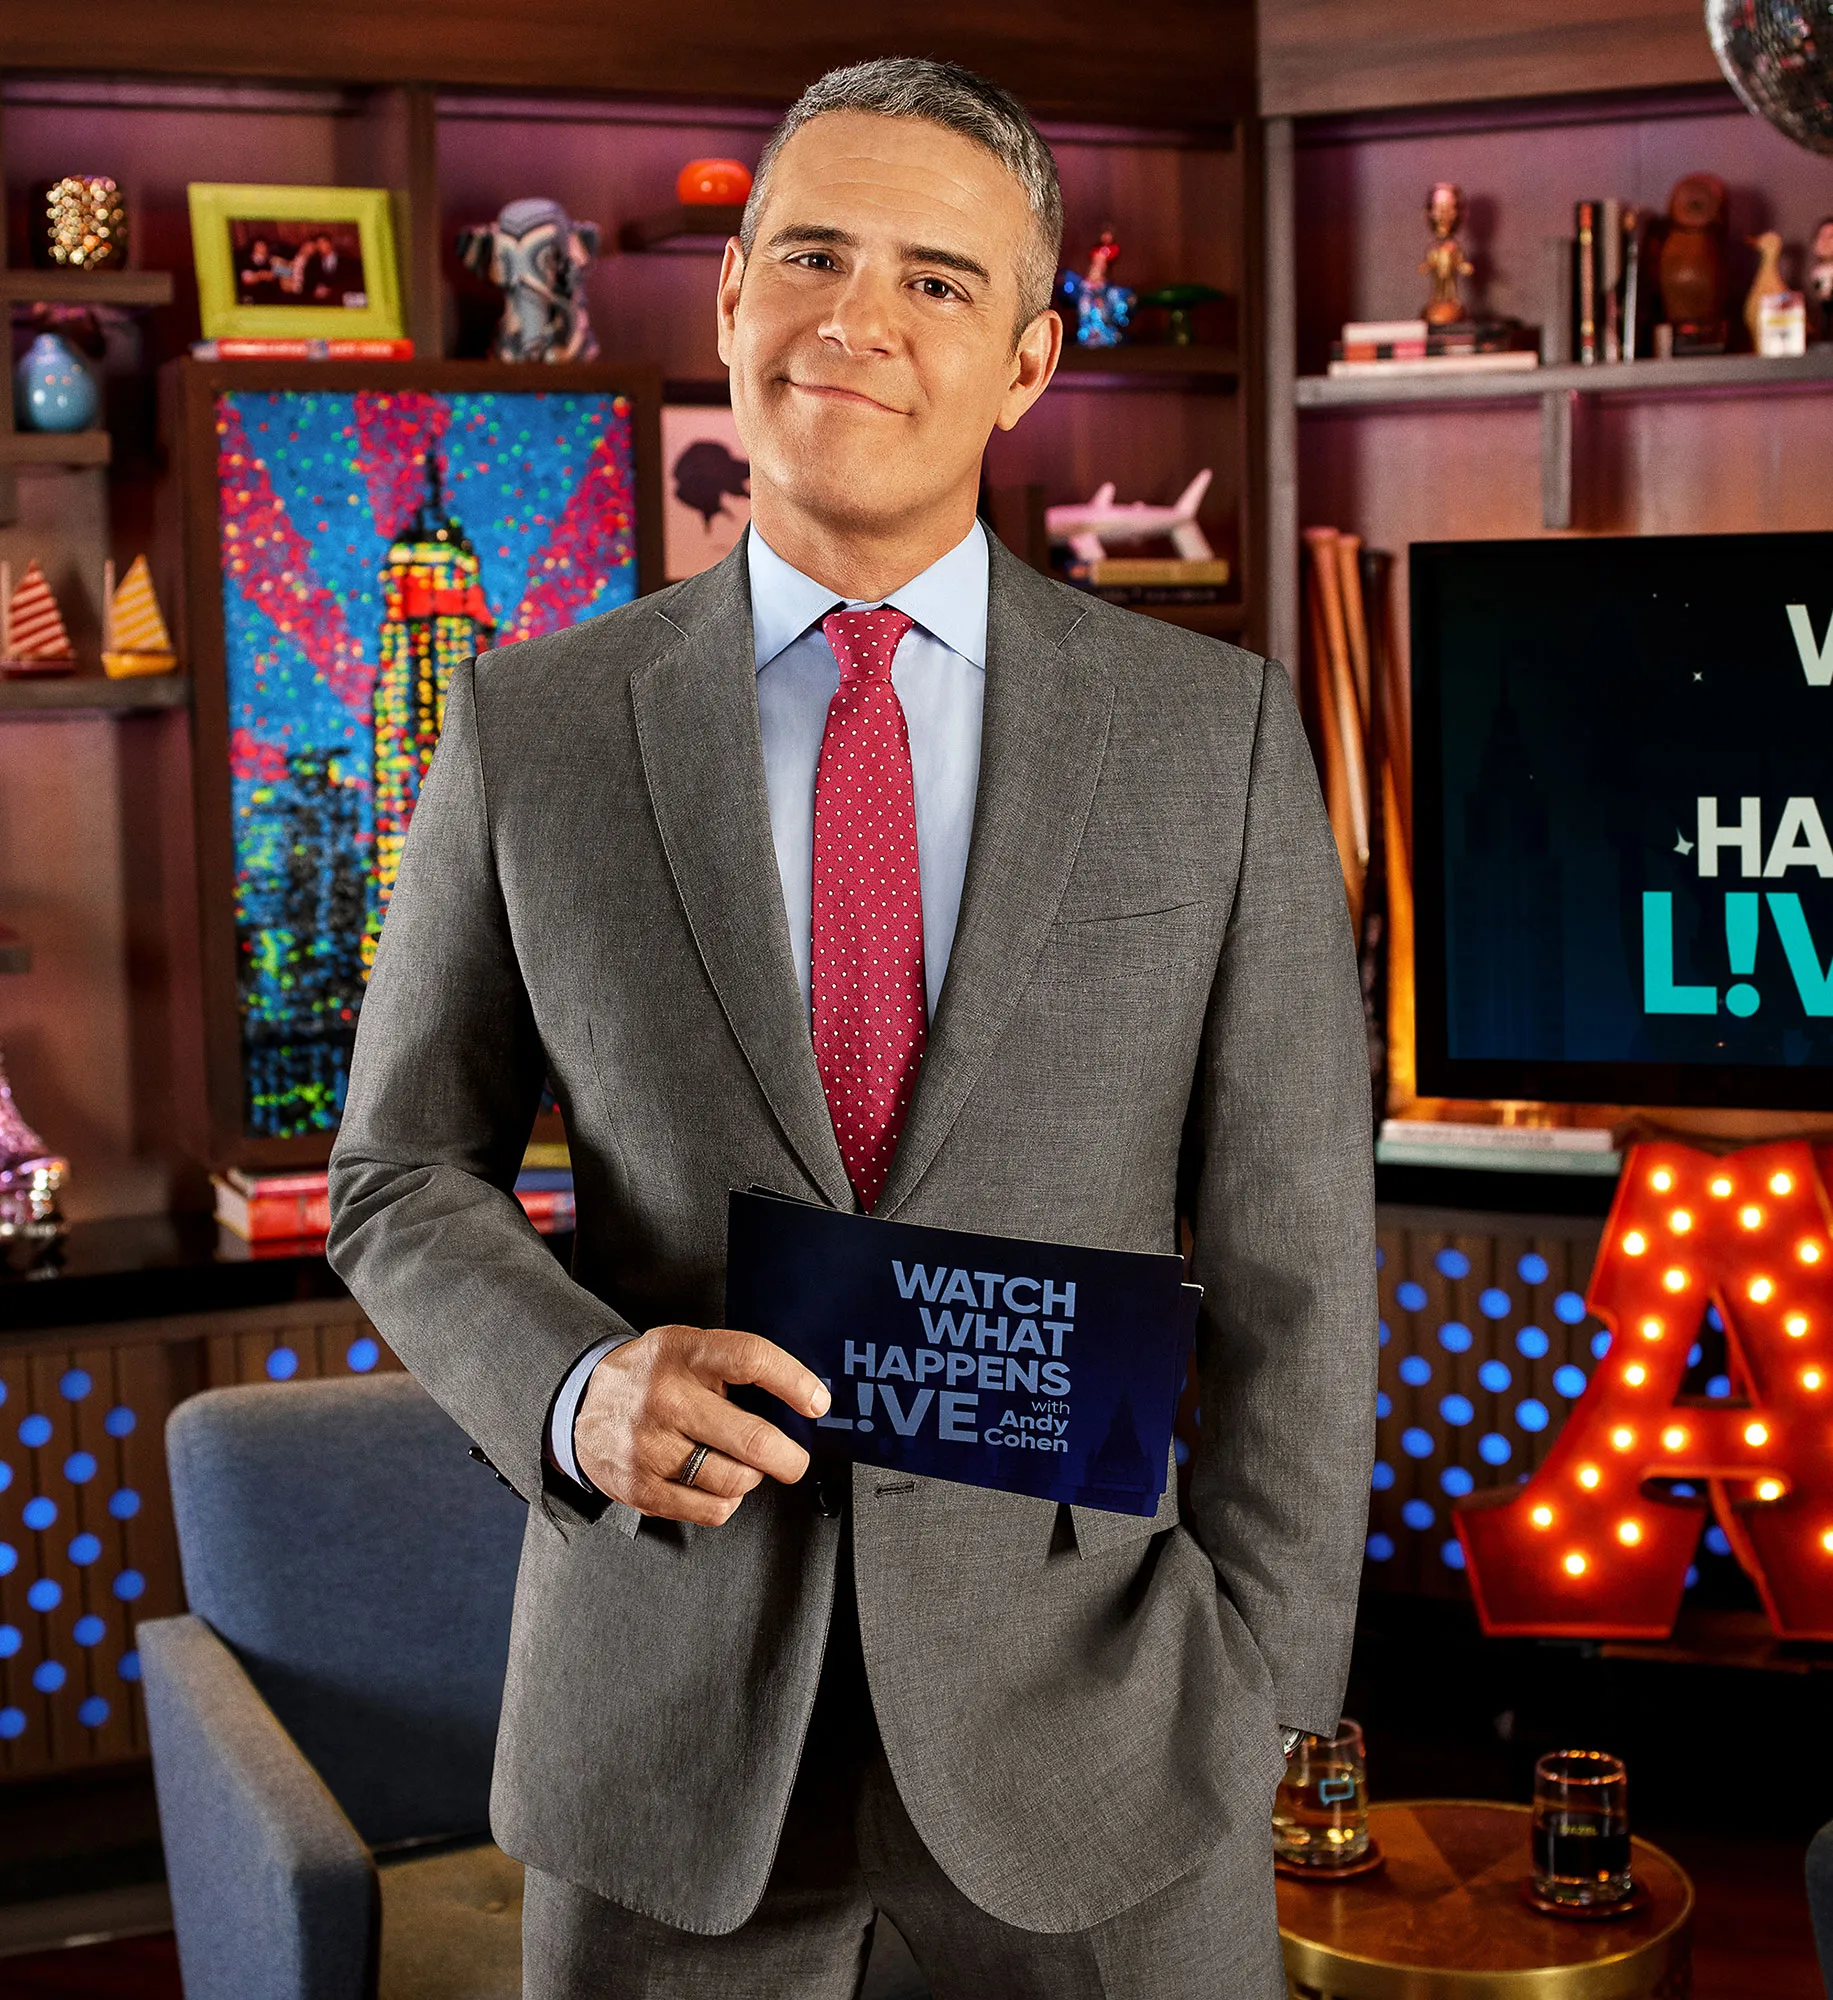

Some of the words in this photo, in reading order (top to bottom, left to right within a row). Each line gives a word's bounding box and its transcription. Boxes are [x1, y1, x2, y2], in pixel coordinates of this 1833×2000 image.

[891, 1259, 1077, 1318] WATCH
[918, 1307, 1075, 1357] WHAT
[843, 1340, 1072, 1396] HAPPENS
[999, 1409, 1069, 1437] Andy
[1031, 1399, 1070, 1415] with
[983, 1427, 1069, 1453] Cohen
